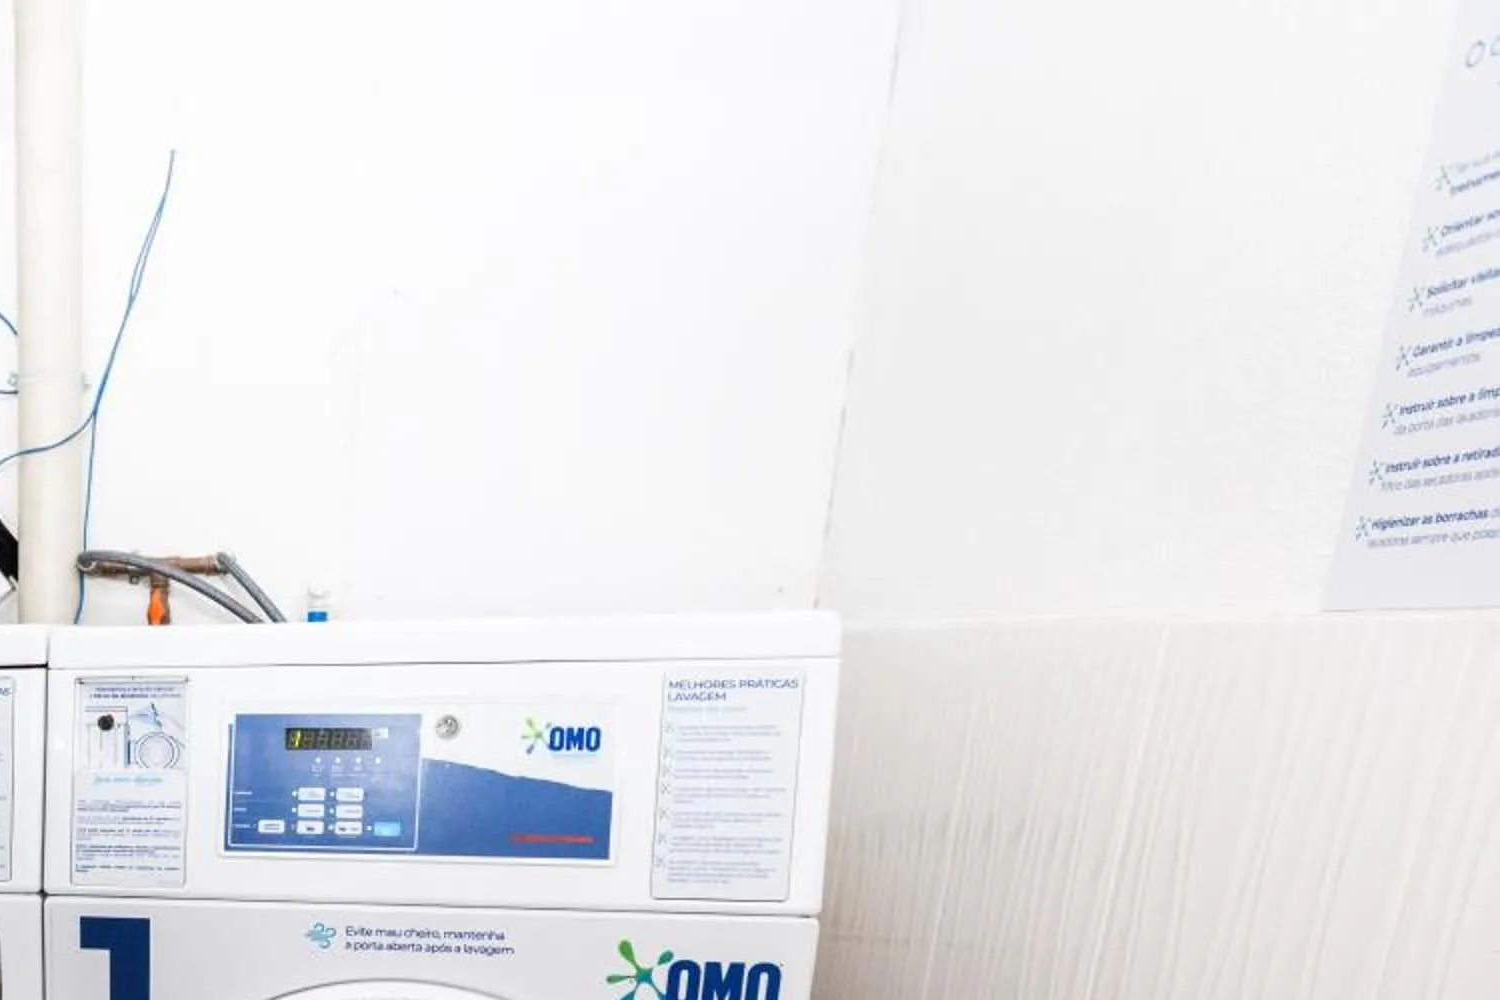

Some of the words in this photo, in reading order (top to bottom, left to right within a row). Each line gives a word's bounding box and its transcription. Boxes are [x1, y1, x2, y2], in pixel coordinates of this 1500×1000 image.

[668, 679, 737, 689] MELHORES
[667, 691, 727, 702] LAVAGEM
[547, 726, 602, 752] OMO
[346, 925, 373, 937] Evite
[375, 928, 402, 938] mau
[443, 929, 506, 941] mantenha
[353, 941, 385, 952] porta
[386, 942, 423, 953] aberta
[463, 943, 516, 957] lavagem
